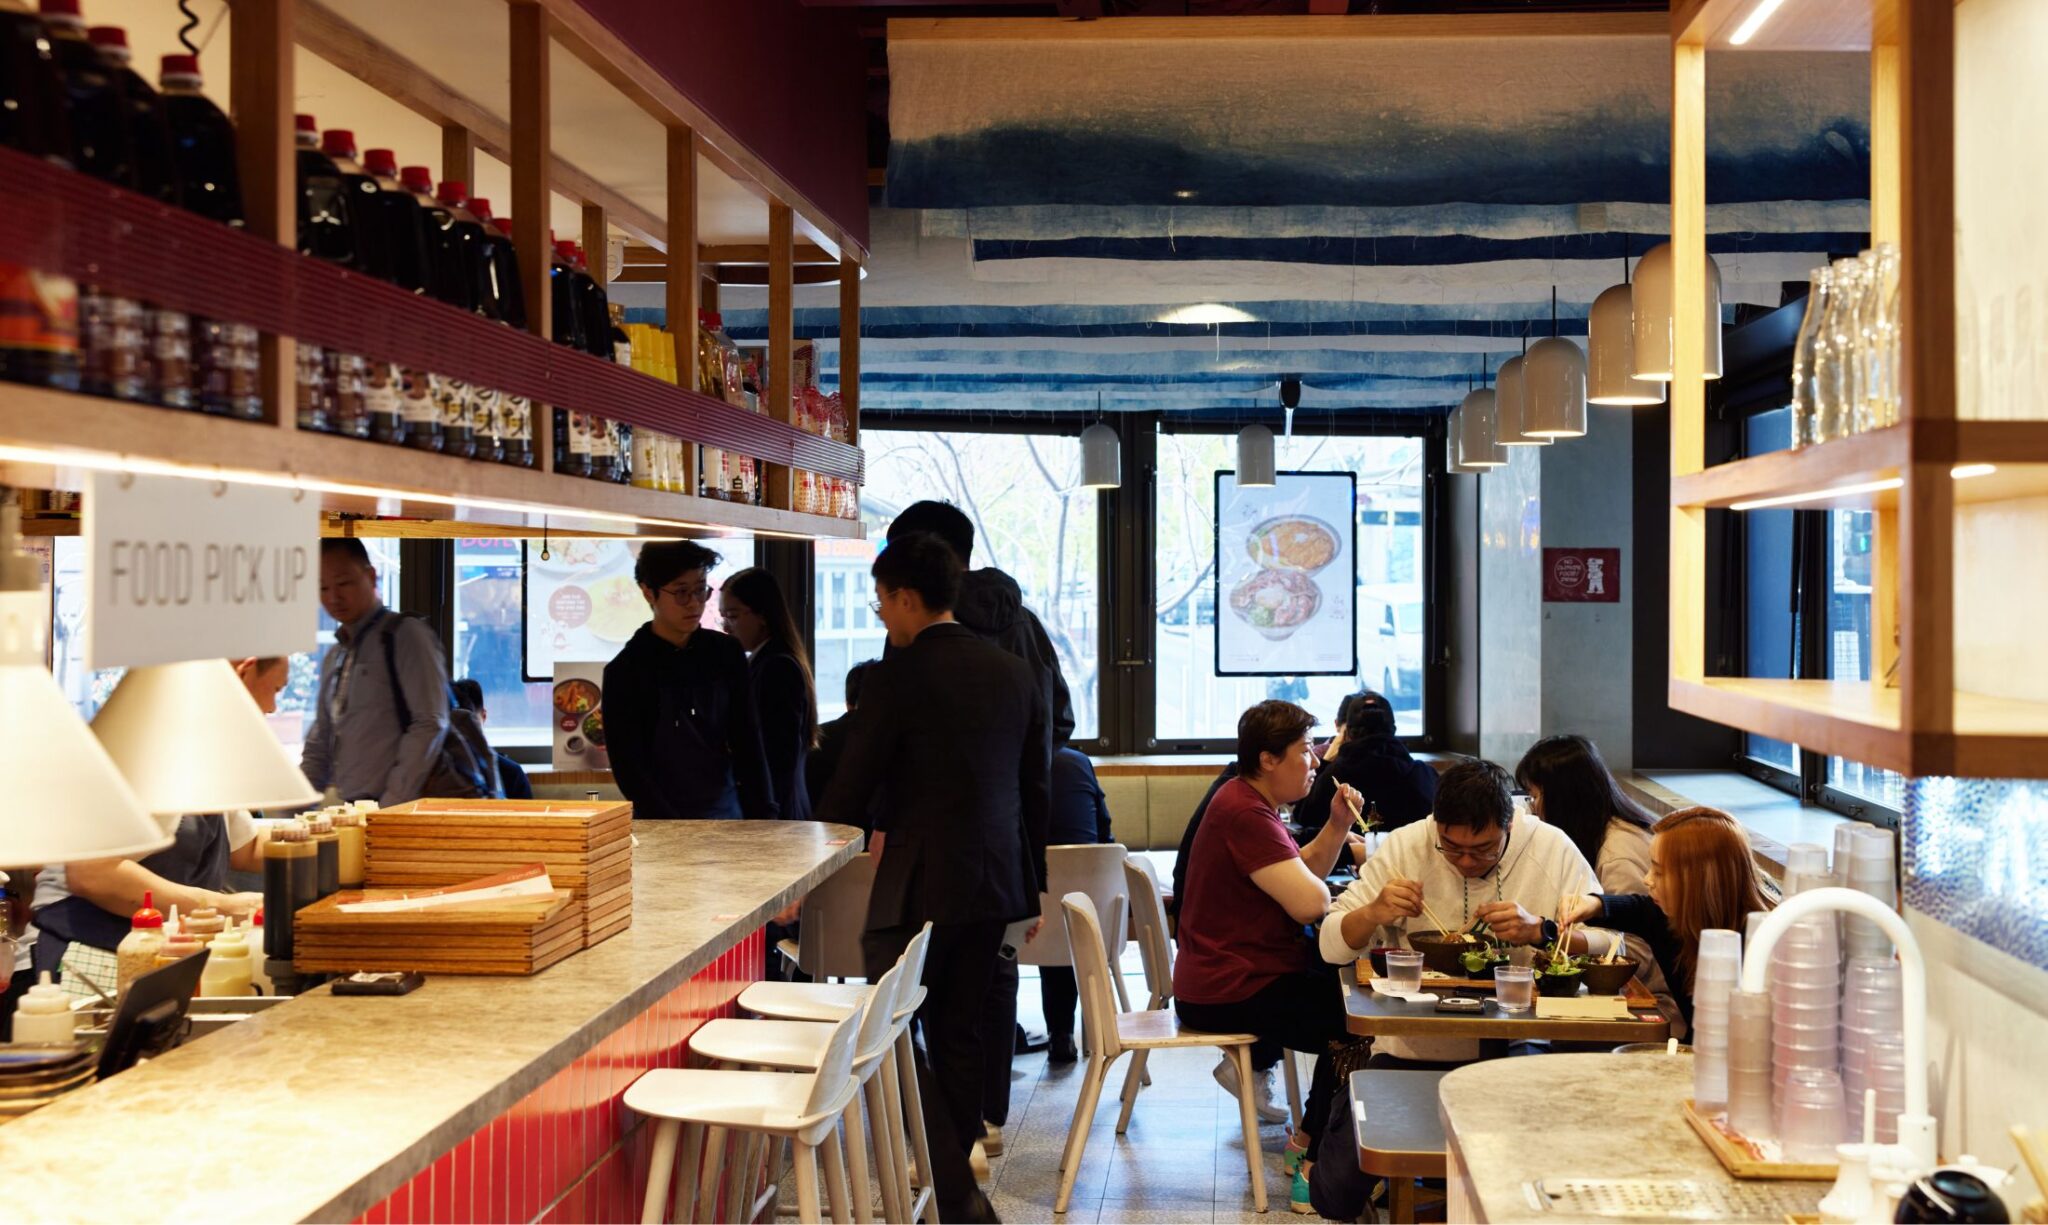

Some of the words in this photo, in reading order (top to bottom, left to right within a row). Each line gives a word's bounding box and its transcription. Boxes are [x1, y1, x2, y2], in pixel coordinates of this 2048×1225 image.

[112, 541, 192, 606] FOOD
[204, 543, 266, 604] PICK
[274, 546, 307, 603] UP
